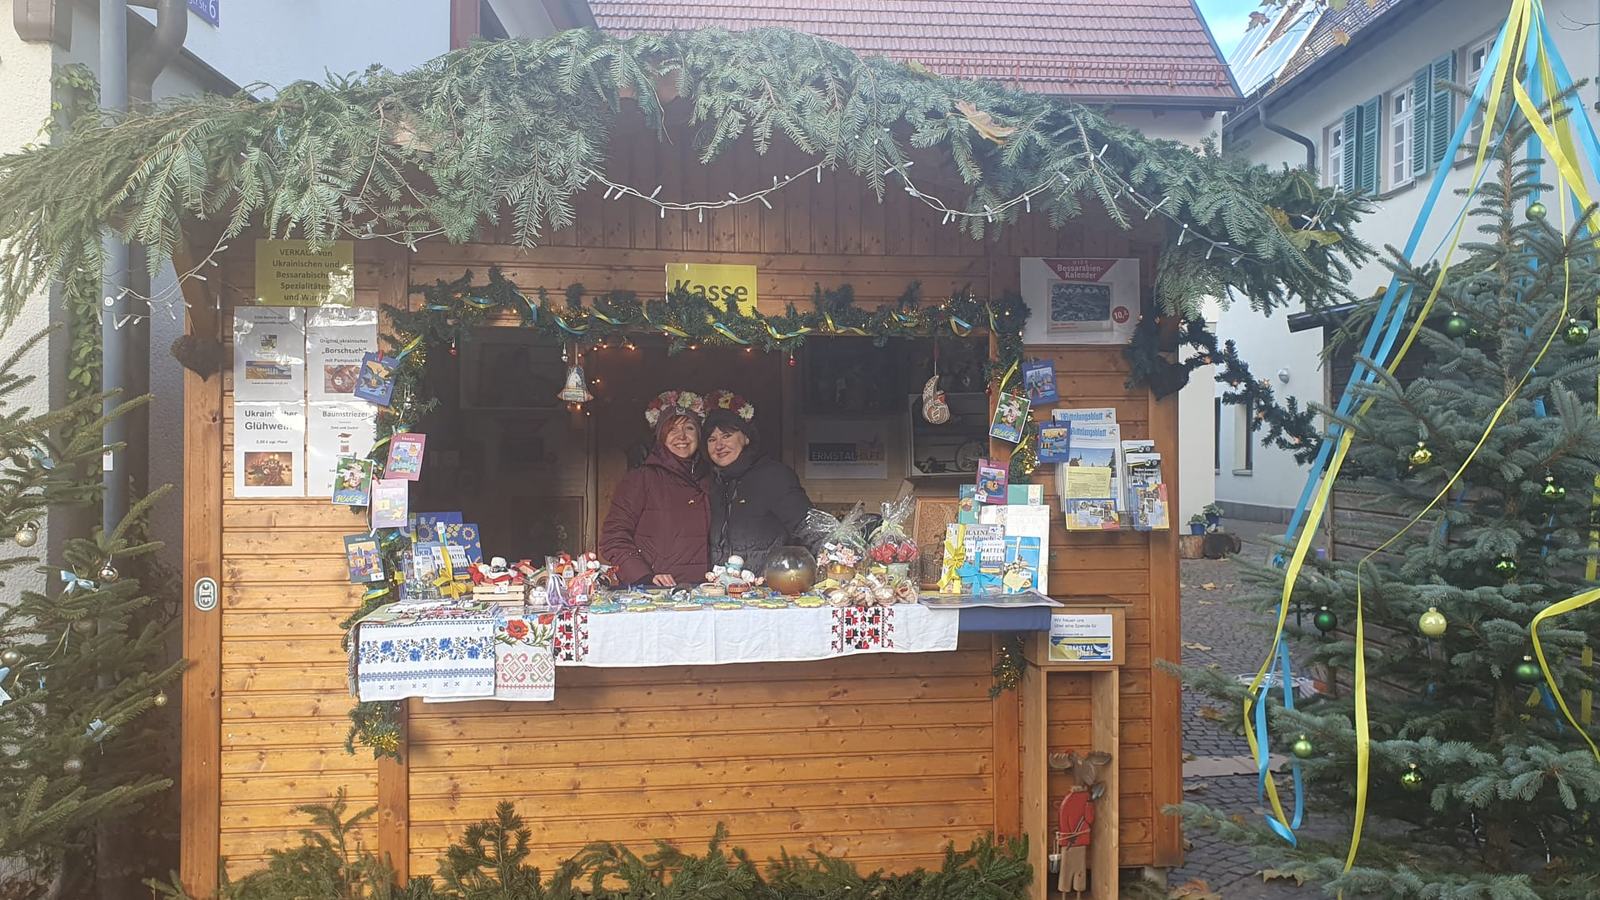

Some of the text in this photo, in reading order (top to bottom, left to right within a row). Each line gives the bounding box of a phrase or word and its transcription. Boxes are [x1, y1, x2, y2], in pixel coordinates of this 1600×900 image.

[209, 0, 216, 18] 6
[279, 248, 315, 257] VERKAU
[272, 259, 340, 268] Ukrainischen und
[275, 271, 332, 279] Bessarabische
[1064, 271, 1097, 279] Kalender
[280, 281, 331, 291] Spezialitäten
[674, 279, 749, 302] Kasse
[244, 421, 292, 430] Glühwei
